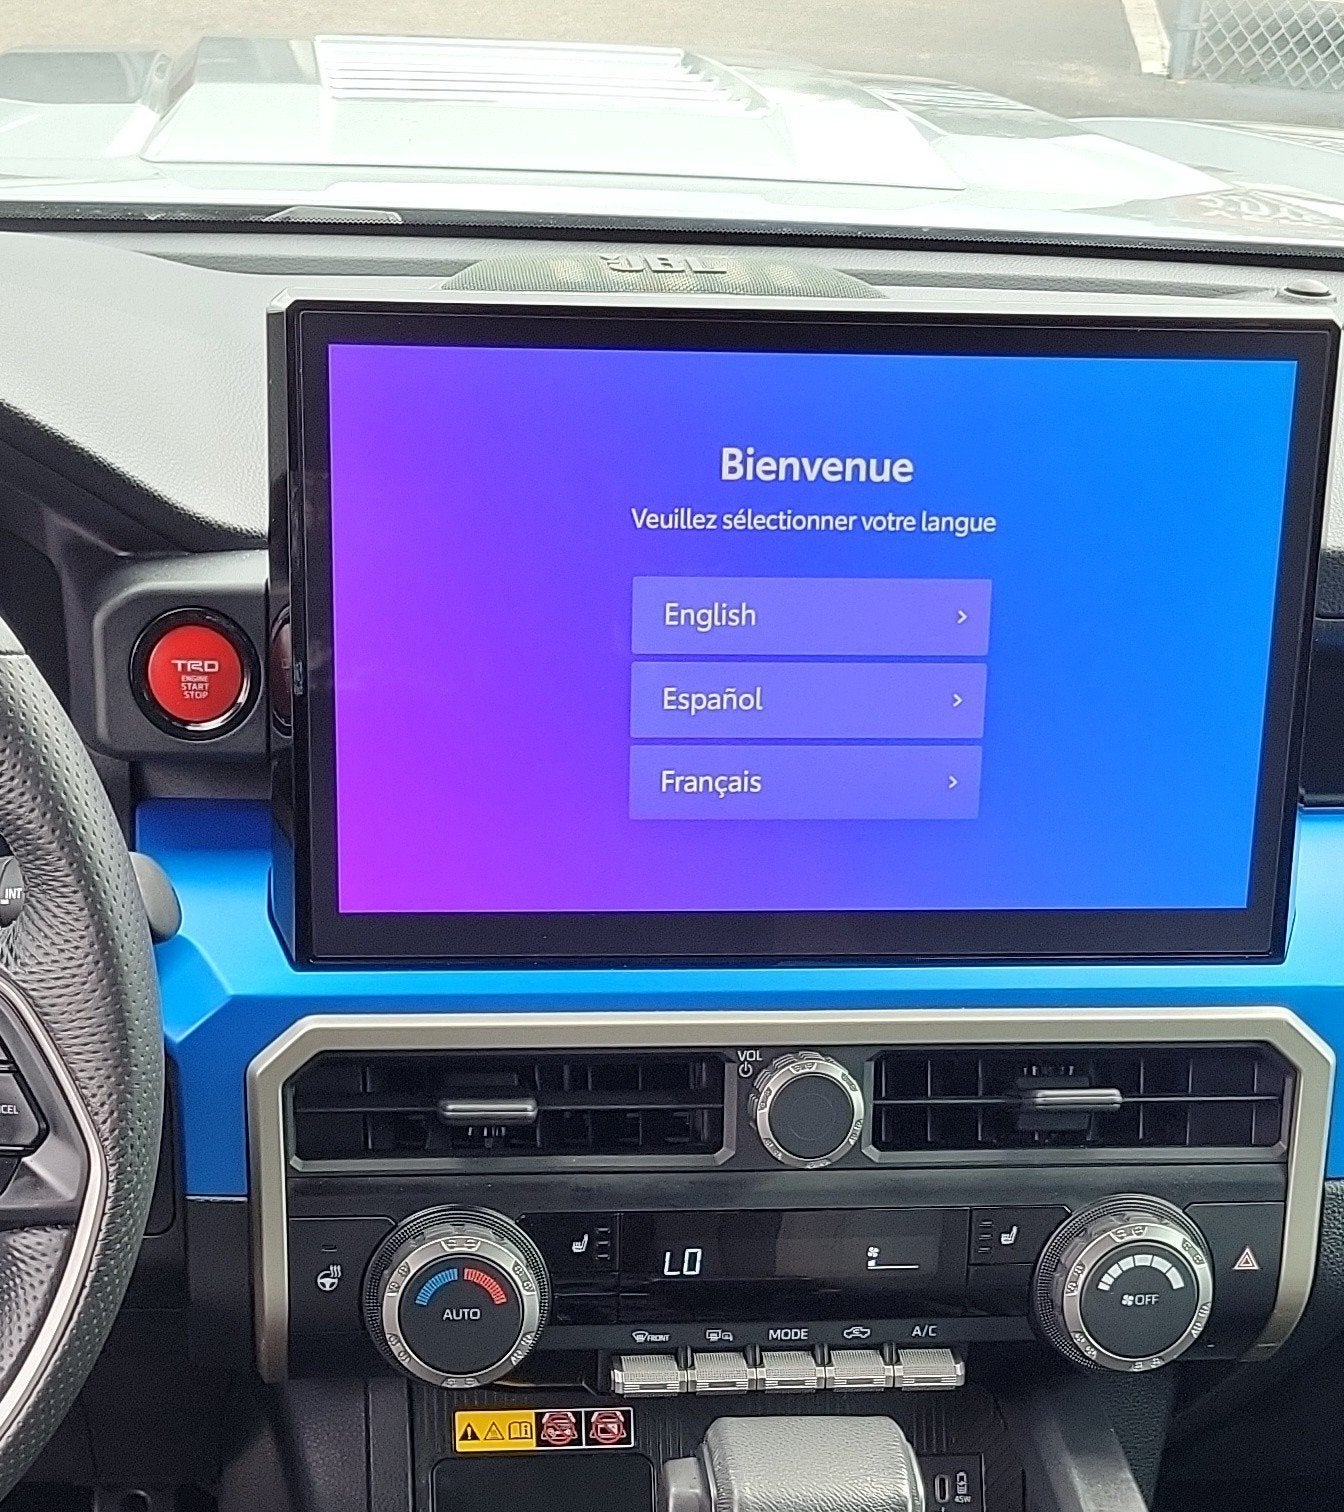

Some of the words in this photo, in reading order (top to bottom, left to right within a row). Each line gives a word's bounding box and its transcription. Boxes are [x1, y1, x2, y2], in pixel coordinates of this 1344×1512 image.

[721, 447, 914, 483] Bienvenue
[631, 507, 718, 530] Veuillez
[722, 507, 857, 532] sélectionner
[861, 513, 917, 532] votre
[921, 510, 997, 537] langue
[664, 602, 757, 632] English
[171, 660, 219, 672] TRD
[181, 683, 210, 692] START
[183, 691, 209, 699] STOP
[662, 686, 763, 716] Español
[661, 769, 762, 800] Français
[5, 887, 23, 899] INT
[737, 1050, 763, 1062] VOL
[663, 1248, 702, 1276] LO
[1135, 1294, 1159, 1306] OFF
[442, 1308, 481, 1321] AUTO
[646, 1333, 671, 1343] FRONT
[768, 1328, 809, 1341] MODE
[911, 1325, 938, 1338] A/C
